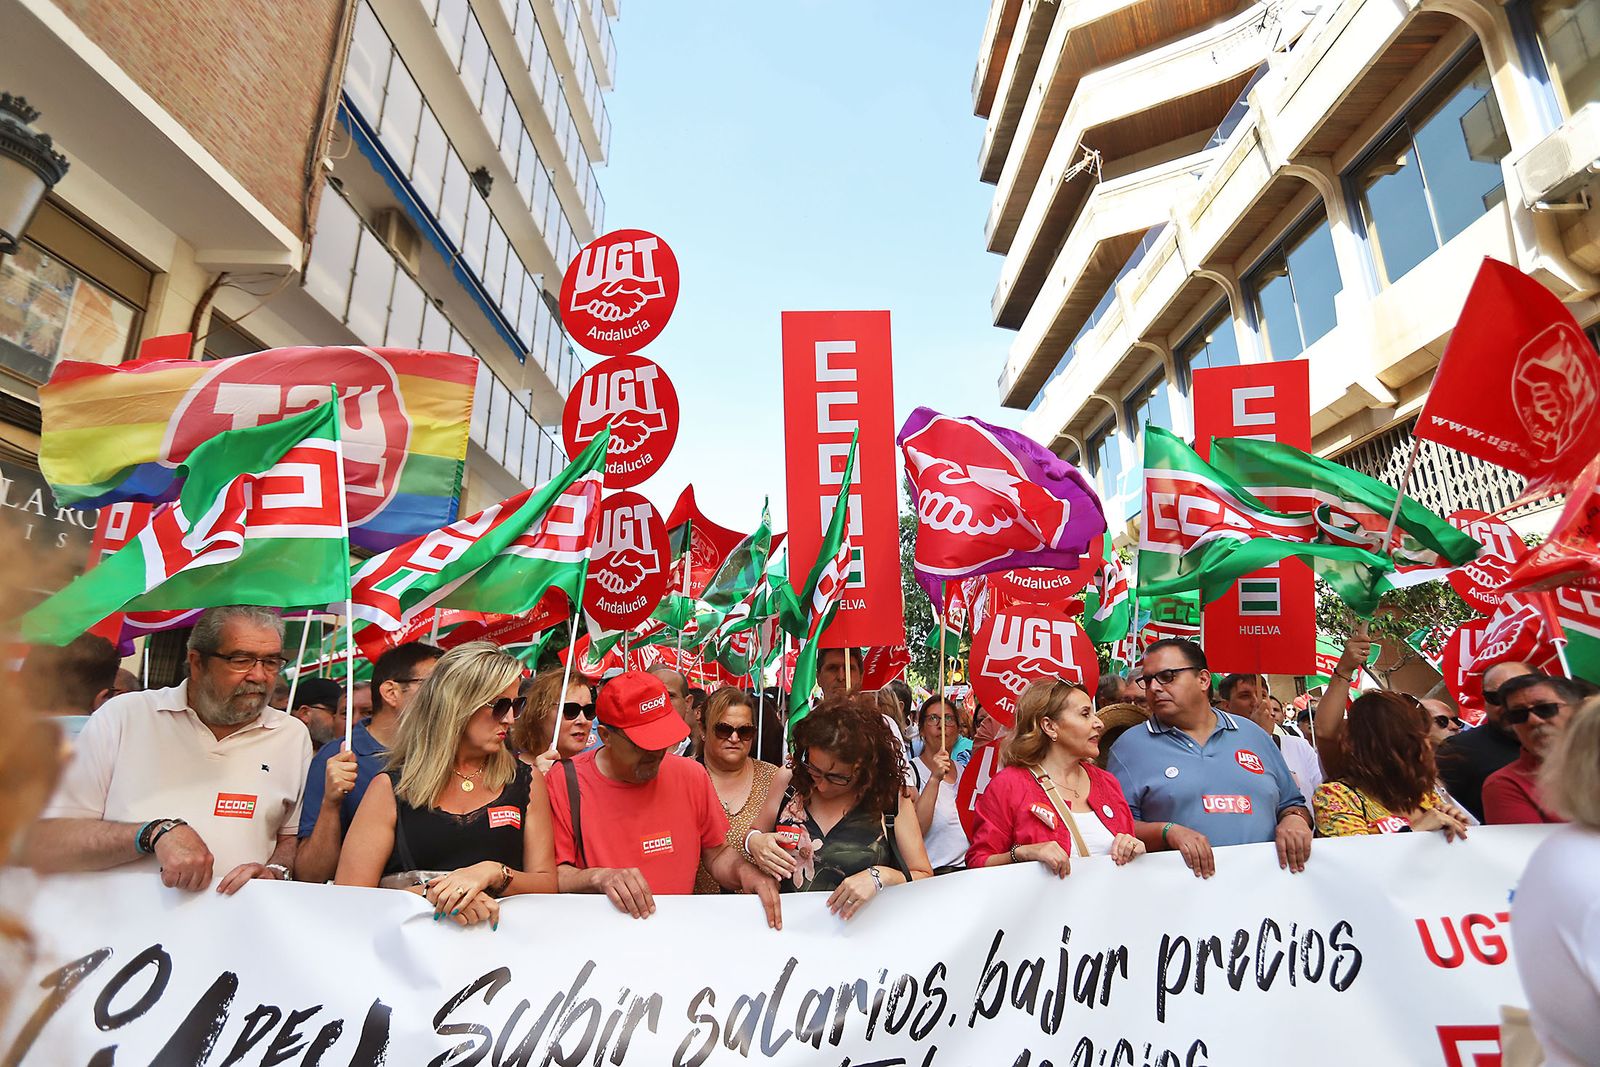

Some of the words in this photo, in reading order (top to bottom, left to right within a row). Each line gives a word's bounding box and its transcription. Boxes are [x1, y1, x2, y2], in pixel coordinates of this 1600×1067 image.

[575, 237, 658, 292] UGT
[587, 319, 650, 341] Andalucía
[579, 365, 658, 422] UGT
[815, 340, 863, 536] CCOO
[604, 453, 653, 474] ndalucía
[590, 503, 653, 560] UGT
[1003, 570, 1072, 589] Andalucía
[596, 595, 648, 615] Andalucía
[839, 599, 866, 610] ELVA
[1239, 625, 1281, 636] HUELVA
[988, 614, 1079, 669] UGT
[218, 799, 248, 810] CCOO
[1203, 797, 1234, 810] UGT
[491, 811, 516, 820] CCOO
[643, 837, 667, 850] CCOO
[427, 960, 663, 1067] Subir
[968, 926, 1128, 1035] bajar
[1157, 918, 1362, 1023] precios
